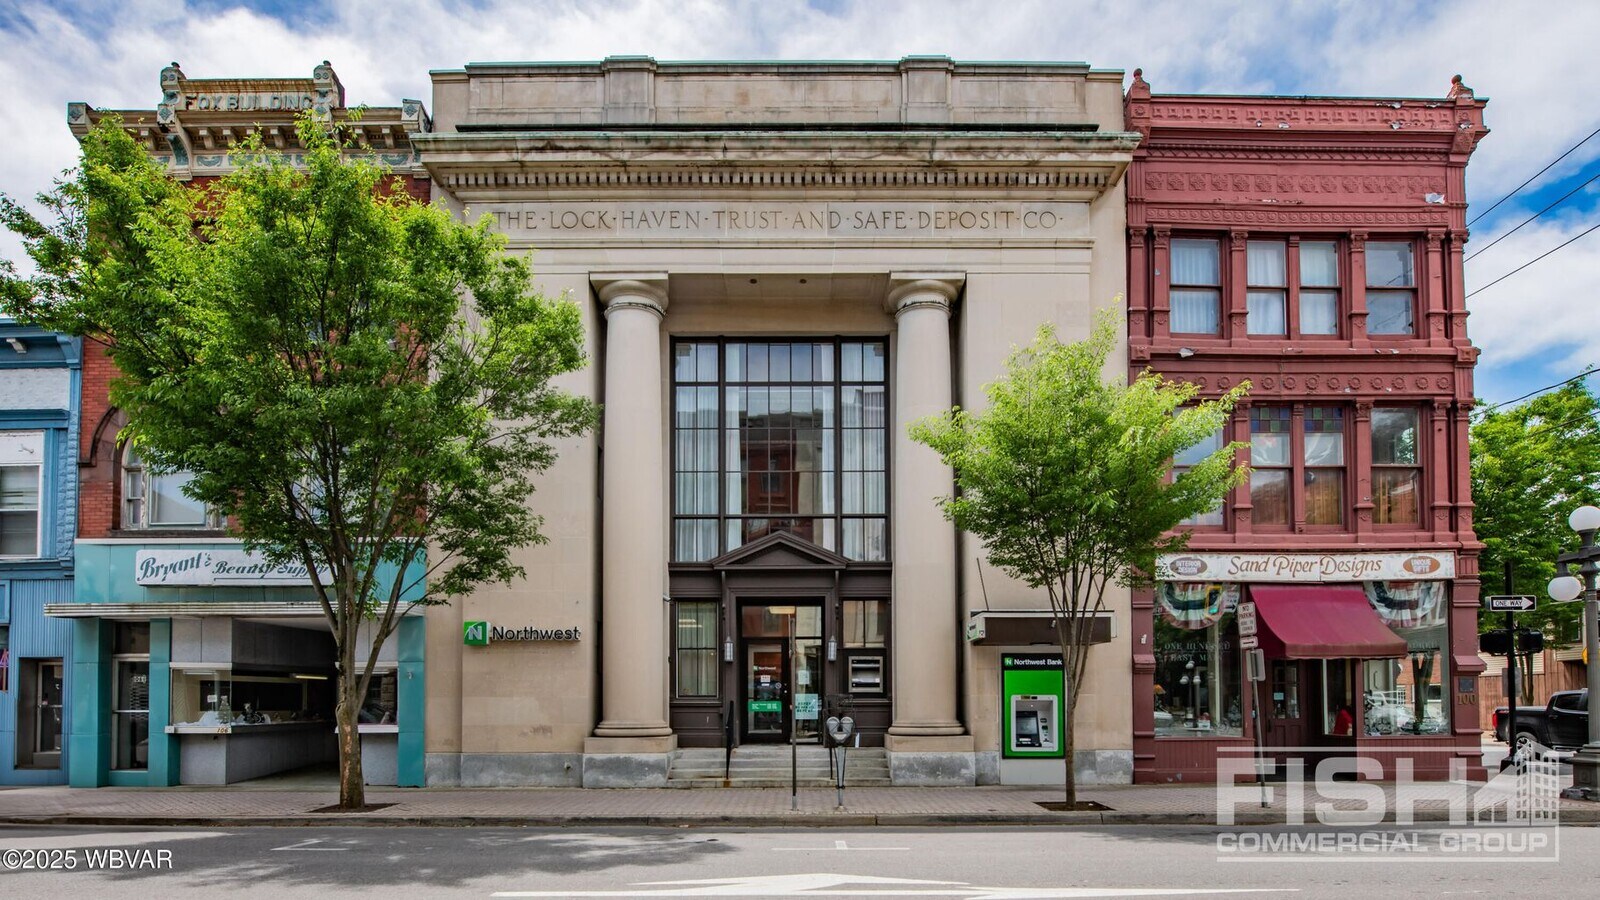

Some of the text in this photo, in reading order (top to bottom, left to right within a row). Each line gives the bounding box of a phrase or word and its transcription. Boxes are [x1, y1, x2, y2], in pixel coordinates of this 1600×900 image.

[185, 94, 222, 110] FOX
[494, 210, 538, 229] THE
[550, 210, 614, 229] LOCK
[621, 210, 700, 229] HAVEN
[712, 210, 783, 229] TRUST
[791, 210, 841, 229] AND
[853, 210, 907, 229] SAFE
[918, 210, 1015, 229] DEPOSIT
[137, 552, 329, 581] Bryant's Beauty Suppy
[1227, 556, 1383, 578] Sand Piper Designs
[492, 626, 580, 640] Northwest
[1457, 693, 1476, 705] 100
